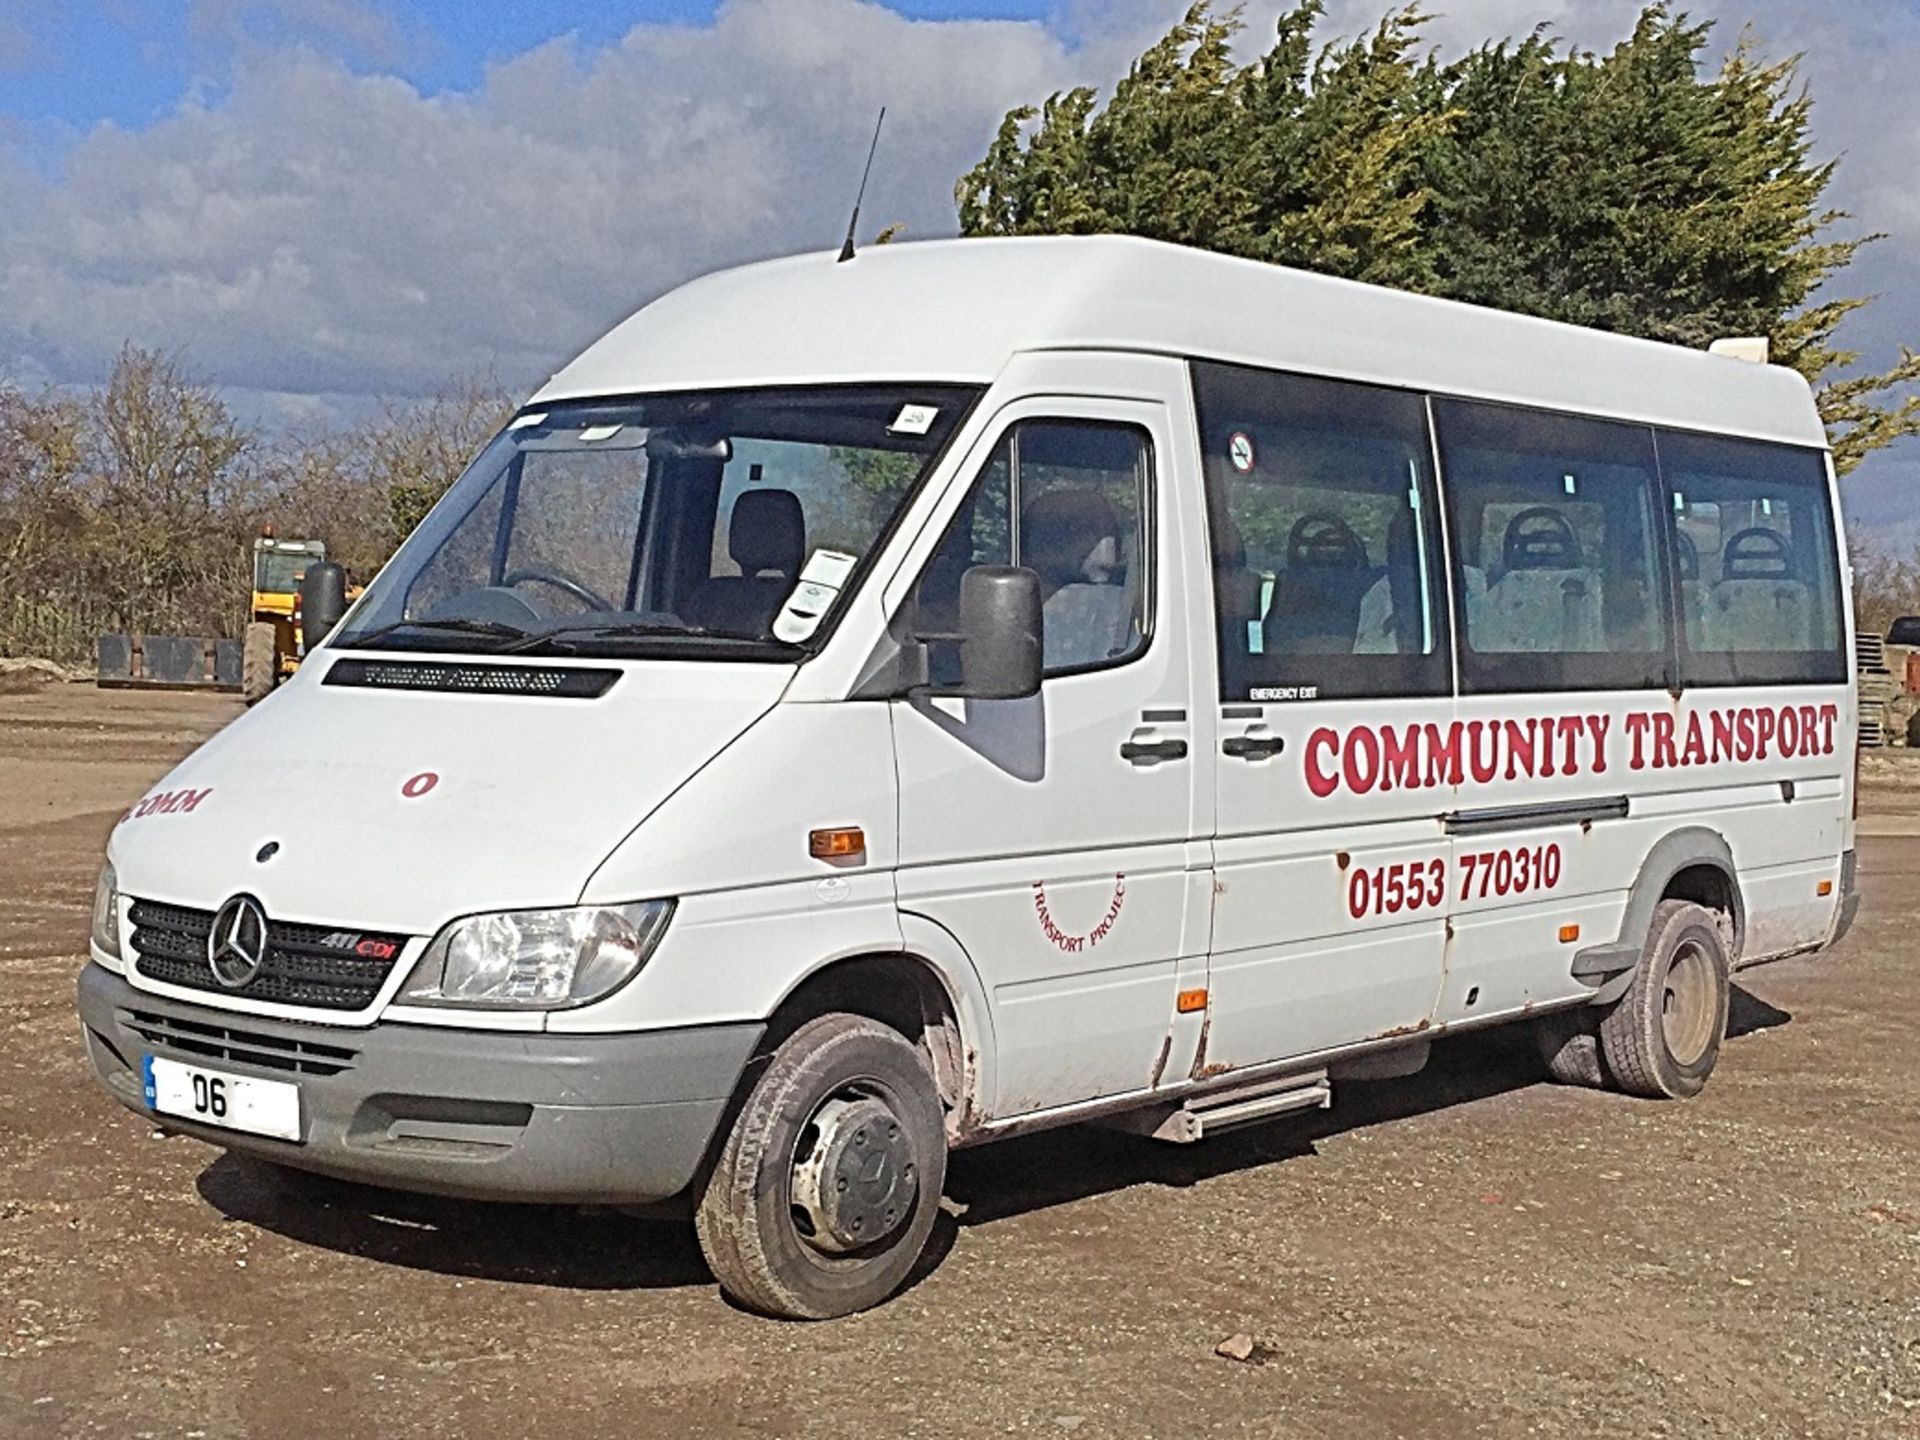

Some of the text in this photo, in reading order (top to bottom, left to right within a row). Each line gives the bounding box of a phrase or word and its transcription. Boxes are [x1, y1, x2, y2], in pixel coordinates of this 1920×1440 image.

[1250, 686, 1318, 700] EMERGENCY EXIT
[1304, 704, 1838, 797] COMMUNITY TRANSPORT
[1350, 843, 1560, 919] 01553 770310
[193, 1074, 227, 1117] 06
